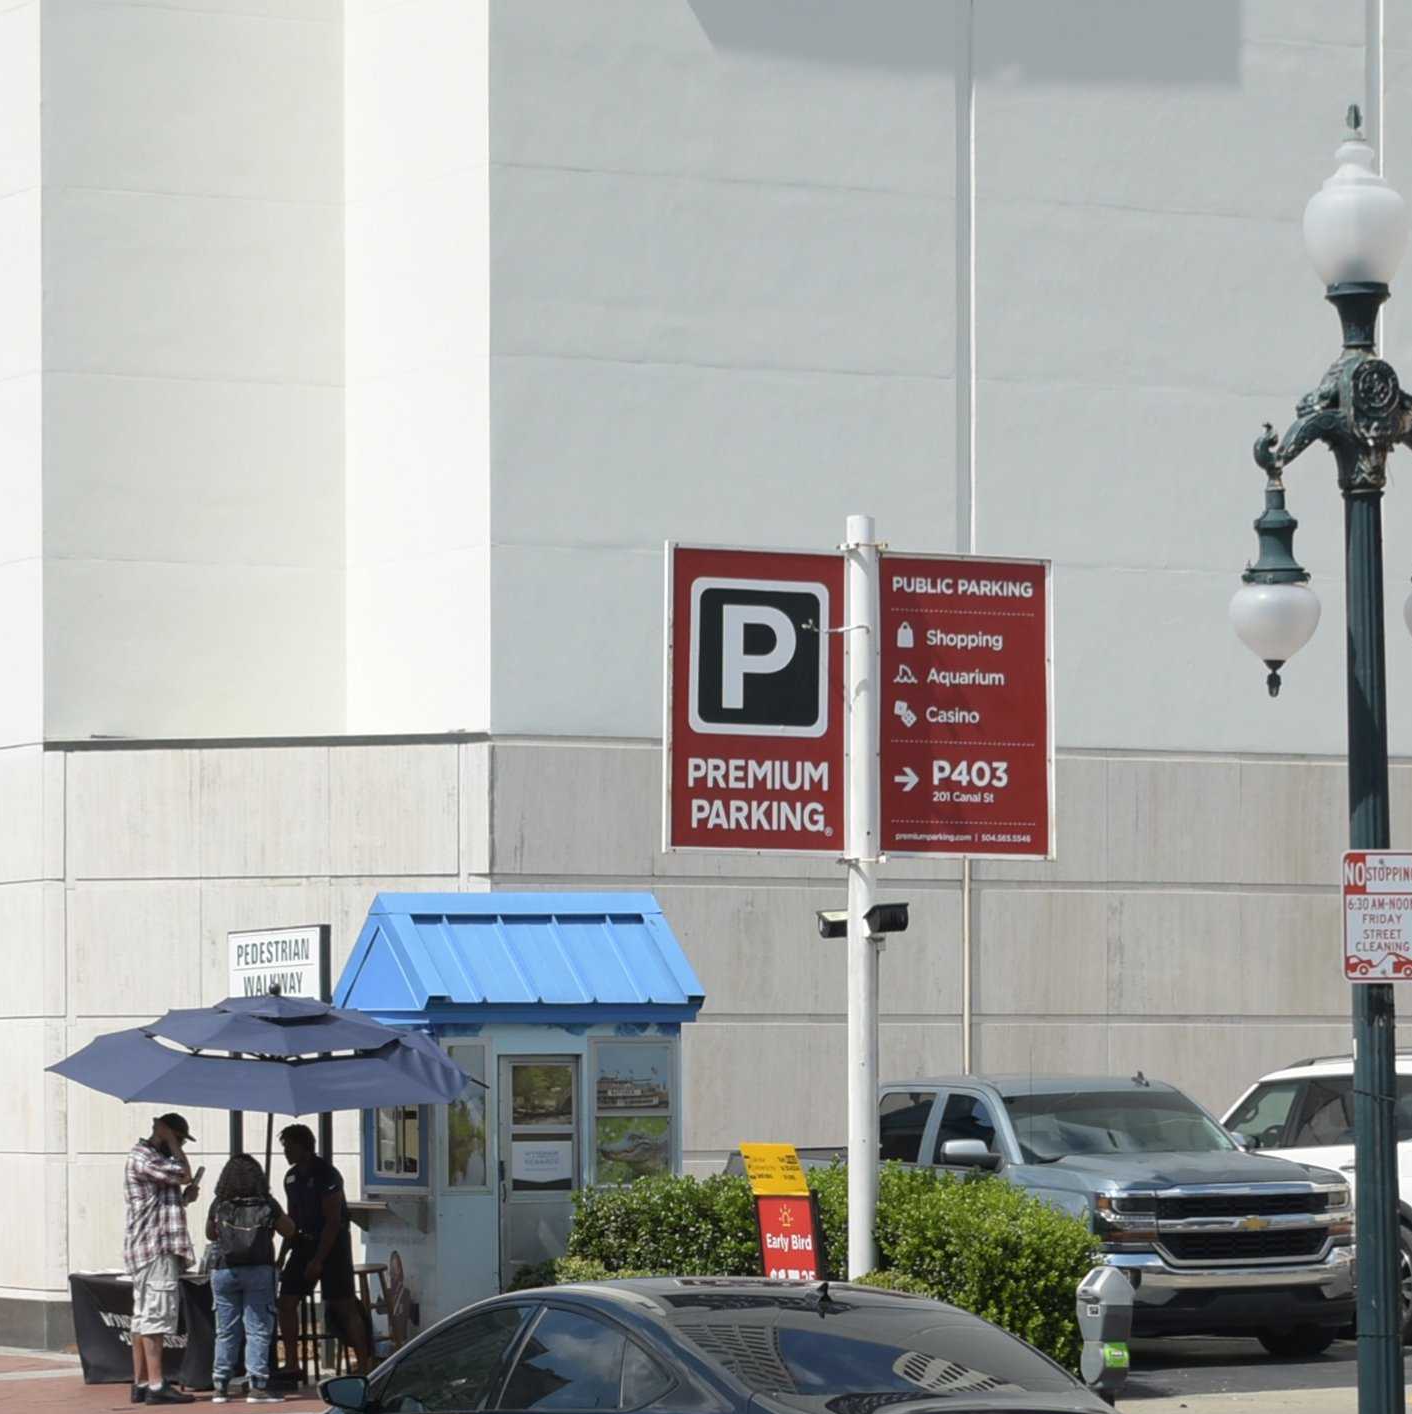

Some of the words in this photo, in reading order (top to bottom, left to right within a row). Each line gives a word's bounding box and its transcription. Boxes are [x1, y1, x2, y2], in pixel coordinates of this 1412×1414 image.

[892, 576, 953, 594] PUBLIC
[957, 579, 1033, 598] PARKING
[926, 629, 1003, 651] Shopping
[722, 604, 797, 709] P
[927, 667, 1004, 687] Aquarium
[925, 706, 980, 724] Casino
[687, 757, 829, 791] PREMIUM
[932, 760, 1009, 788] P403
[932, 791, 951, 802] 201
[952, 791, 981, 803] Canal
[983, 792, 994, 803] St
[1344, 860, 1365, 887] NO
[1347, 897, 1369, 910] 6:30
[1362, 913, 1403, 924] FRIDAY
[1363, 929, 1402, 940] STREET
[236, 937, 310, 967] PEDESTRIAN
[1355, 941, 1410, 952] CLEANING
[765, 1233, 789, 1252] Early
[791, 1234, 813, 1250] Bird
